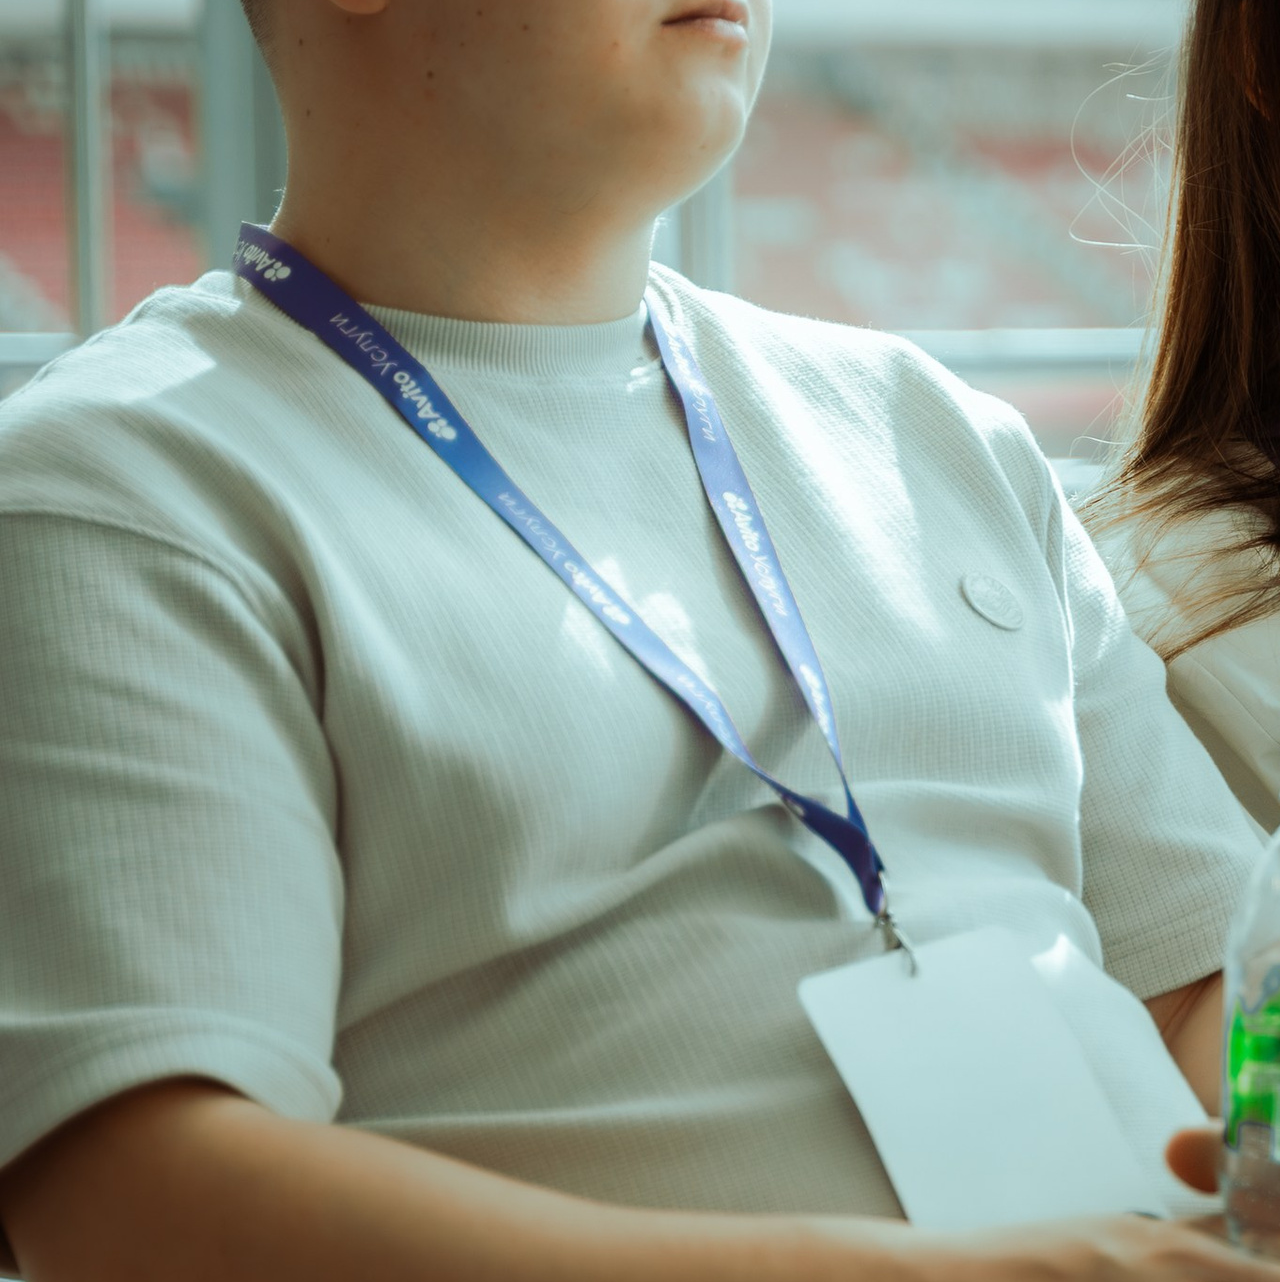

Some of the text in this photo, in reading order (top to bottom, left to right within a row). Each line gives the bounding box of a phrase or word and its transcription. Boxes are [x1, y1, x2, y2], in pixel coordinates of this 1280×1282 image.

[243, 244, 276, 272] Avito
[329, 313, 442, 419] Avito Услуги
[498, 491, 567, 560] Услуги
[730, 508, 788, 617] Avito Услуги
